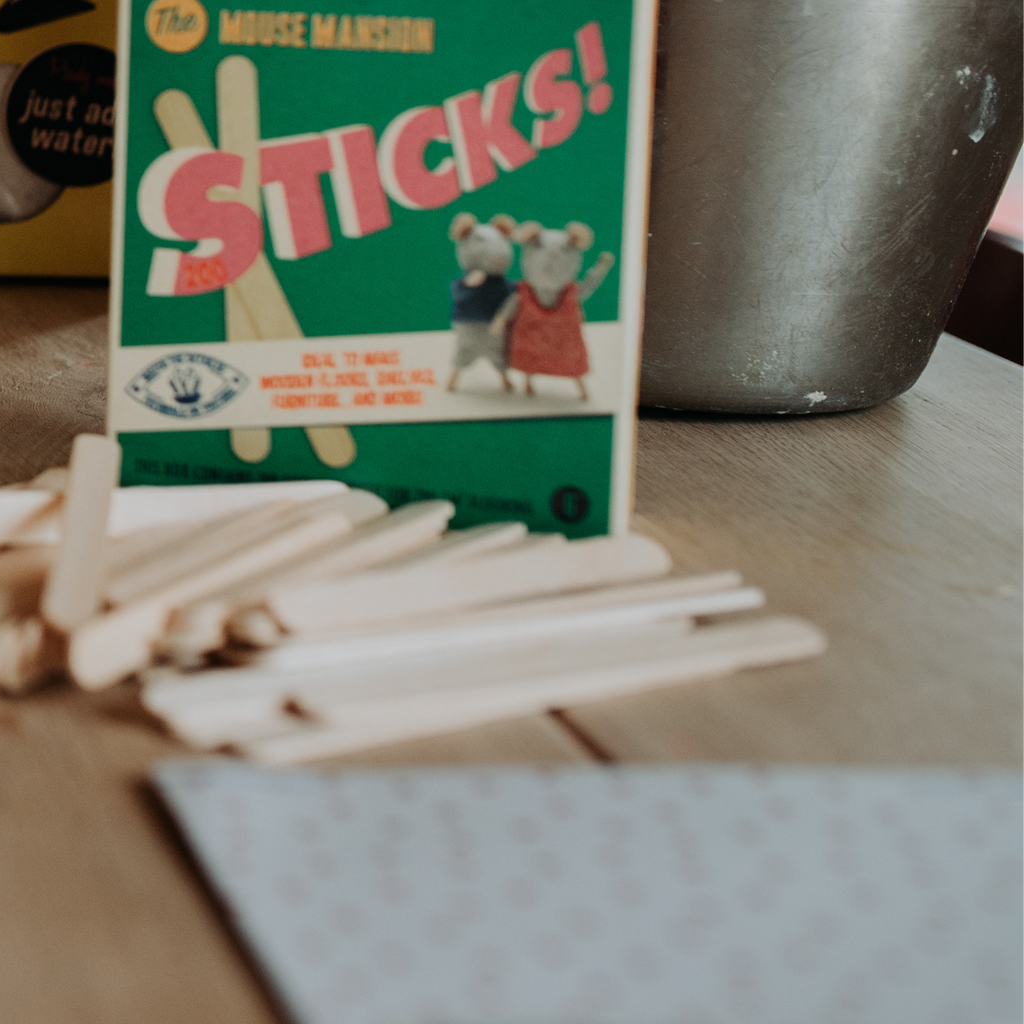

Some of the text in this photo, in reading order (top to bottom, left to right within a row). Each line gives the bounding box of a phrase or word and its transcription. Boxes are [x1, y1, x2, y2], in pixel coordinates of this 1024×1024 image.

[155, 6, 436, 55] The MOUSE MANSION
[17, 88, 79, 125] just
[136, 20, 614, 298] STICKS!
